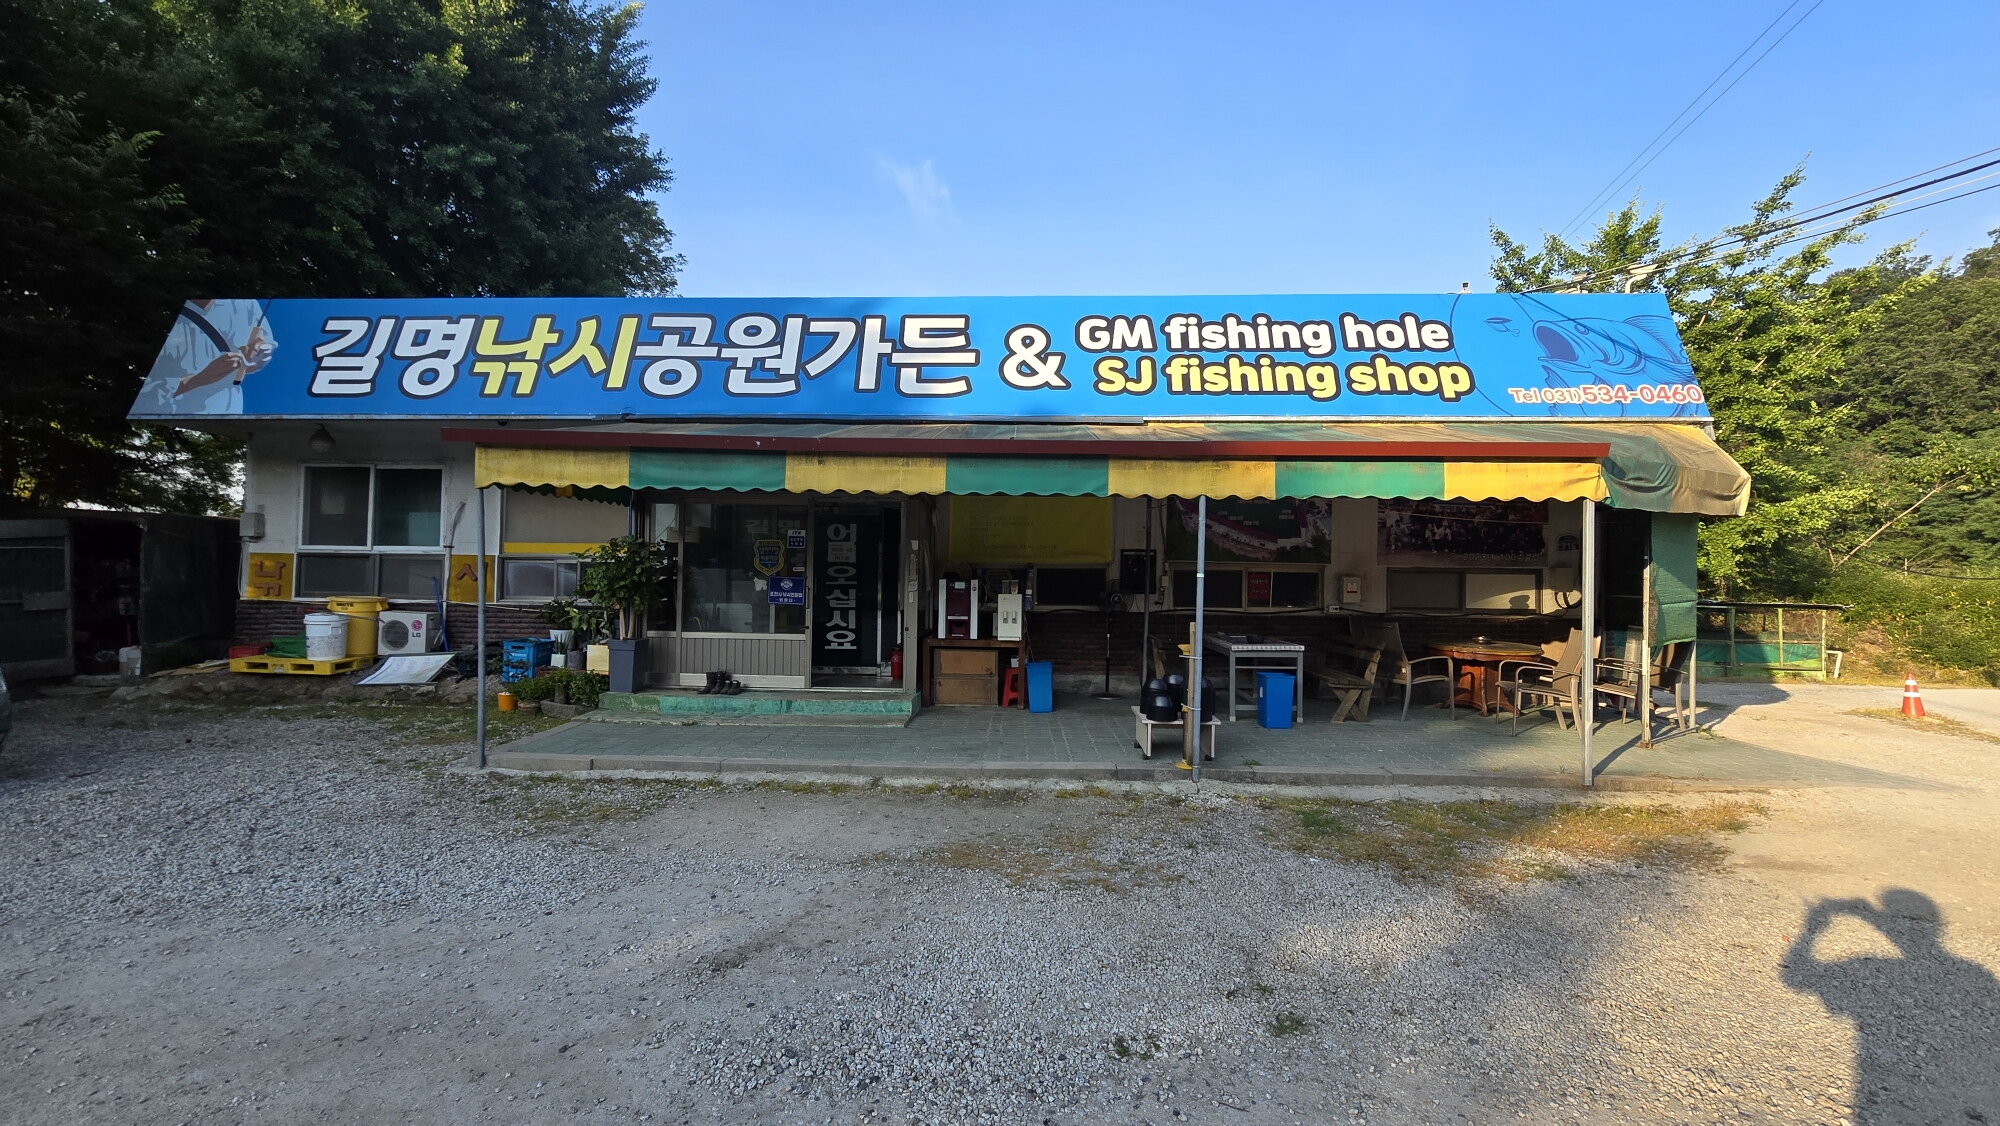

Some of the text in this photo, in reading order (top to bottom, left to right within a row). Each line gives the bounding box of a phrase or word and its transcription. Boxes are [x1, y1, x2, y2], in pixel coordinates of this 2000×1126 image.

[309, 315, 1068, 396] 길명낚시공원가든 &
[1077, 315, 1451, 355] GM fishing hole
[1095, 357, 1472, 398] SJ fishing shop
[1509, 388, 1539, 402] Tel
[825, 523, 857, 651] 어오십시요
